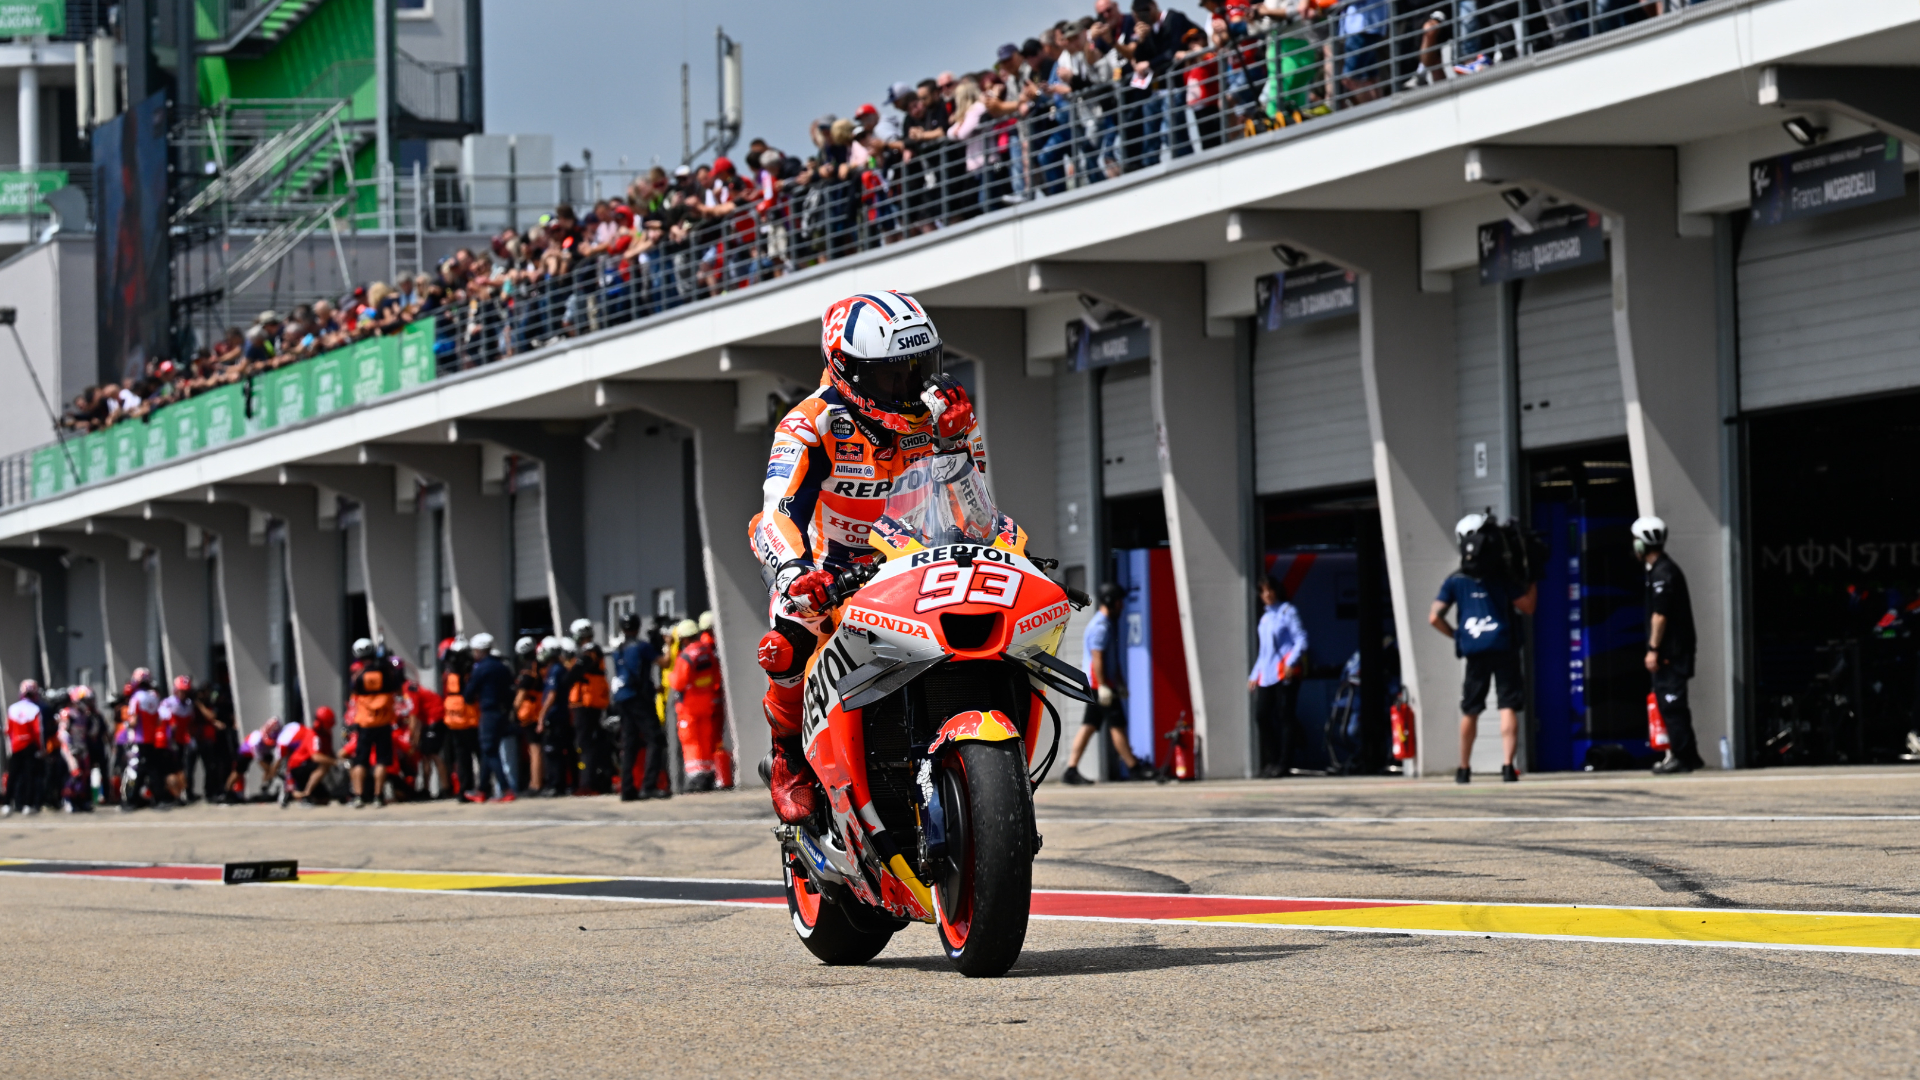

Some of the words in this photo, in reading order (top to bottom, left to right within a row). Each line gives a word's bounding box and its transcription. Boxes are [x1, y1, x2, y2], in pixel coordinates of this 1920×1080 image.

[897, 332, 930, 350] SHOEI
[888, 354, 911, 363] GIVES
[914, 350, 927, 359] YOU
[844, 383, 865, 409] Bull
[856, 421, 880, 446] REPSOL
[901, 435, 928, 446] SHOEI
[836, 452, 849, 460] Red
[849, 453, 863, 461] Bull
[836, 465, 863, 474] Allianz
[845, 534, 869, 545] One
[911, 545, 1016, 568] REPSOL
[915, 560, 1024, 614] 93
[849, 608, 930, 639] HONDA
[1017, 602, 1071, 634] HONDA
[843, 622, 867, 637] HRC
[802, 636, 866, 747] REPSOL
